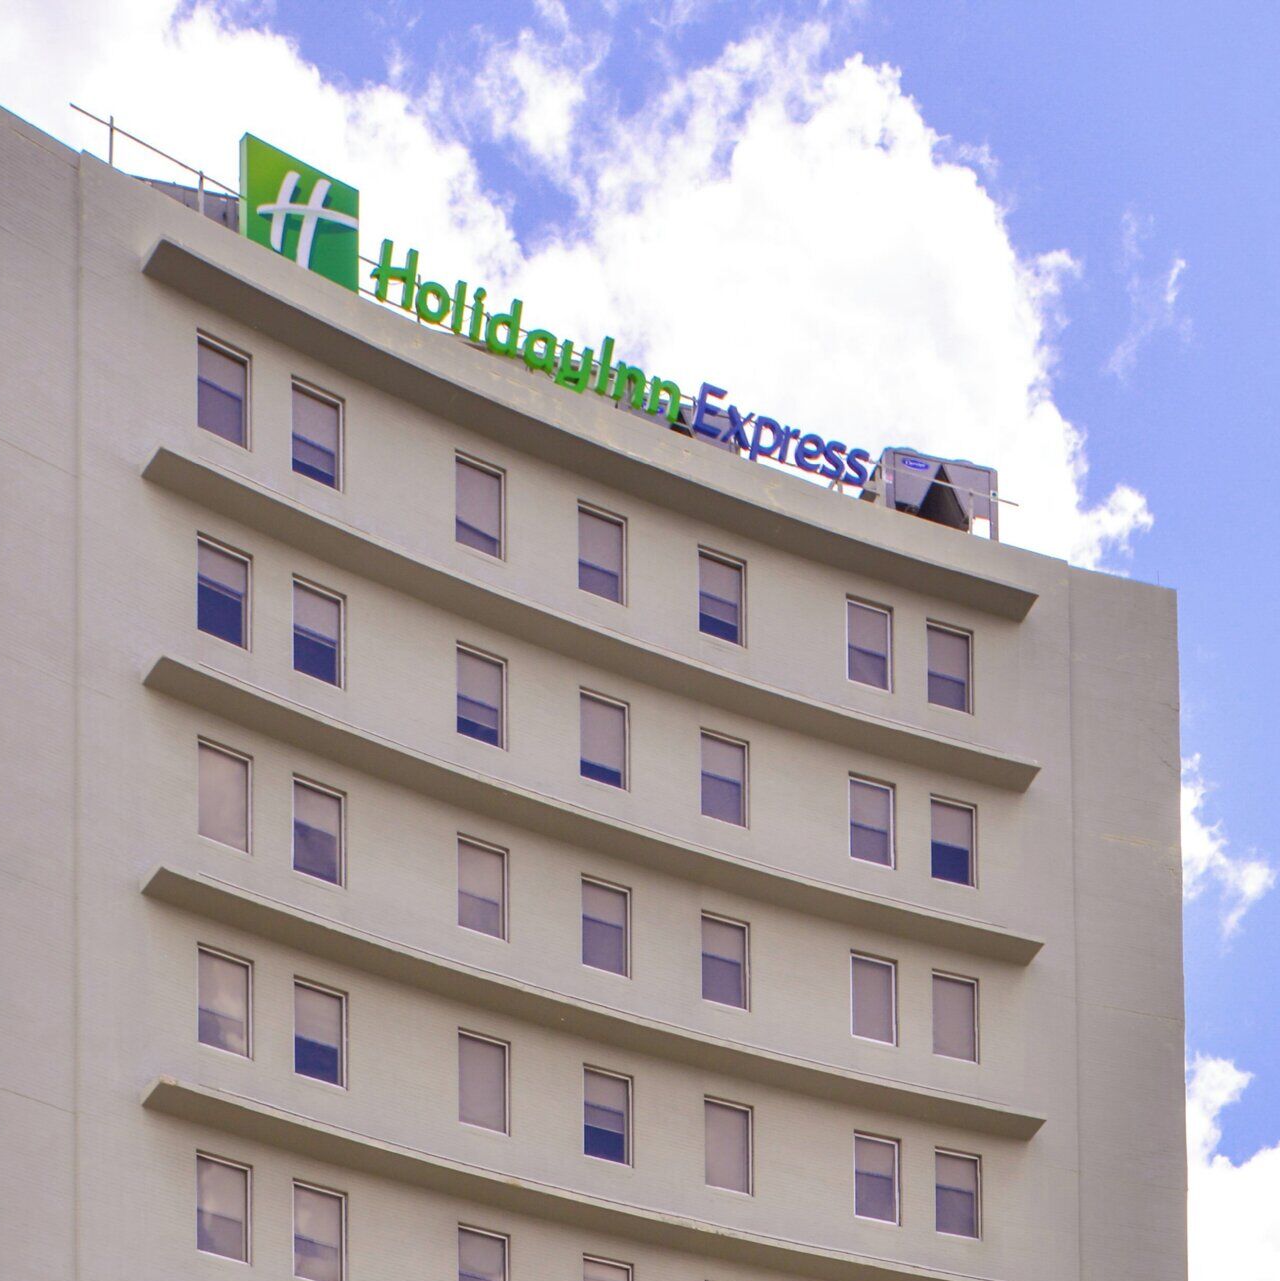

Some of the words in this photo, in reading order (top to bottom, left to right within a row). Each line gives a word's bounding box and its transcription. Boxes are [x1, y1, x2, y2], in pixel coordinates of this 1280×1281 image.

[370, 238, 594, 394] Holiday
[594, 335, 681, 423] Inn
[691, 381, 870, 487] Express
